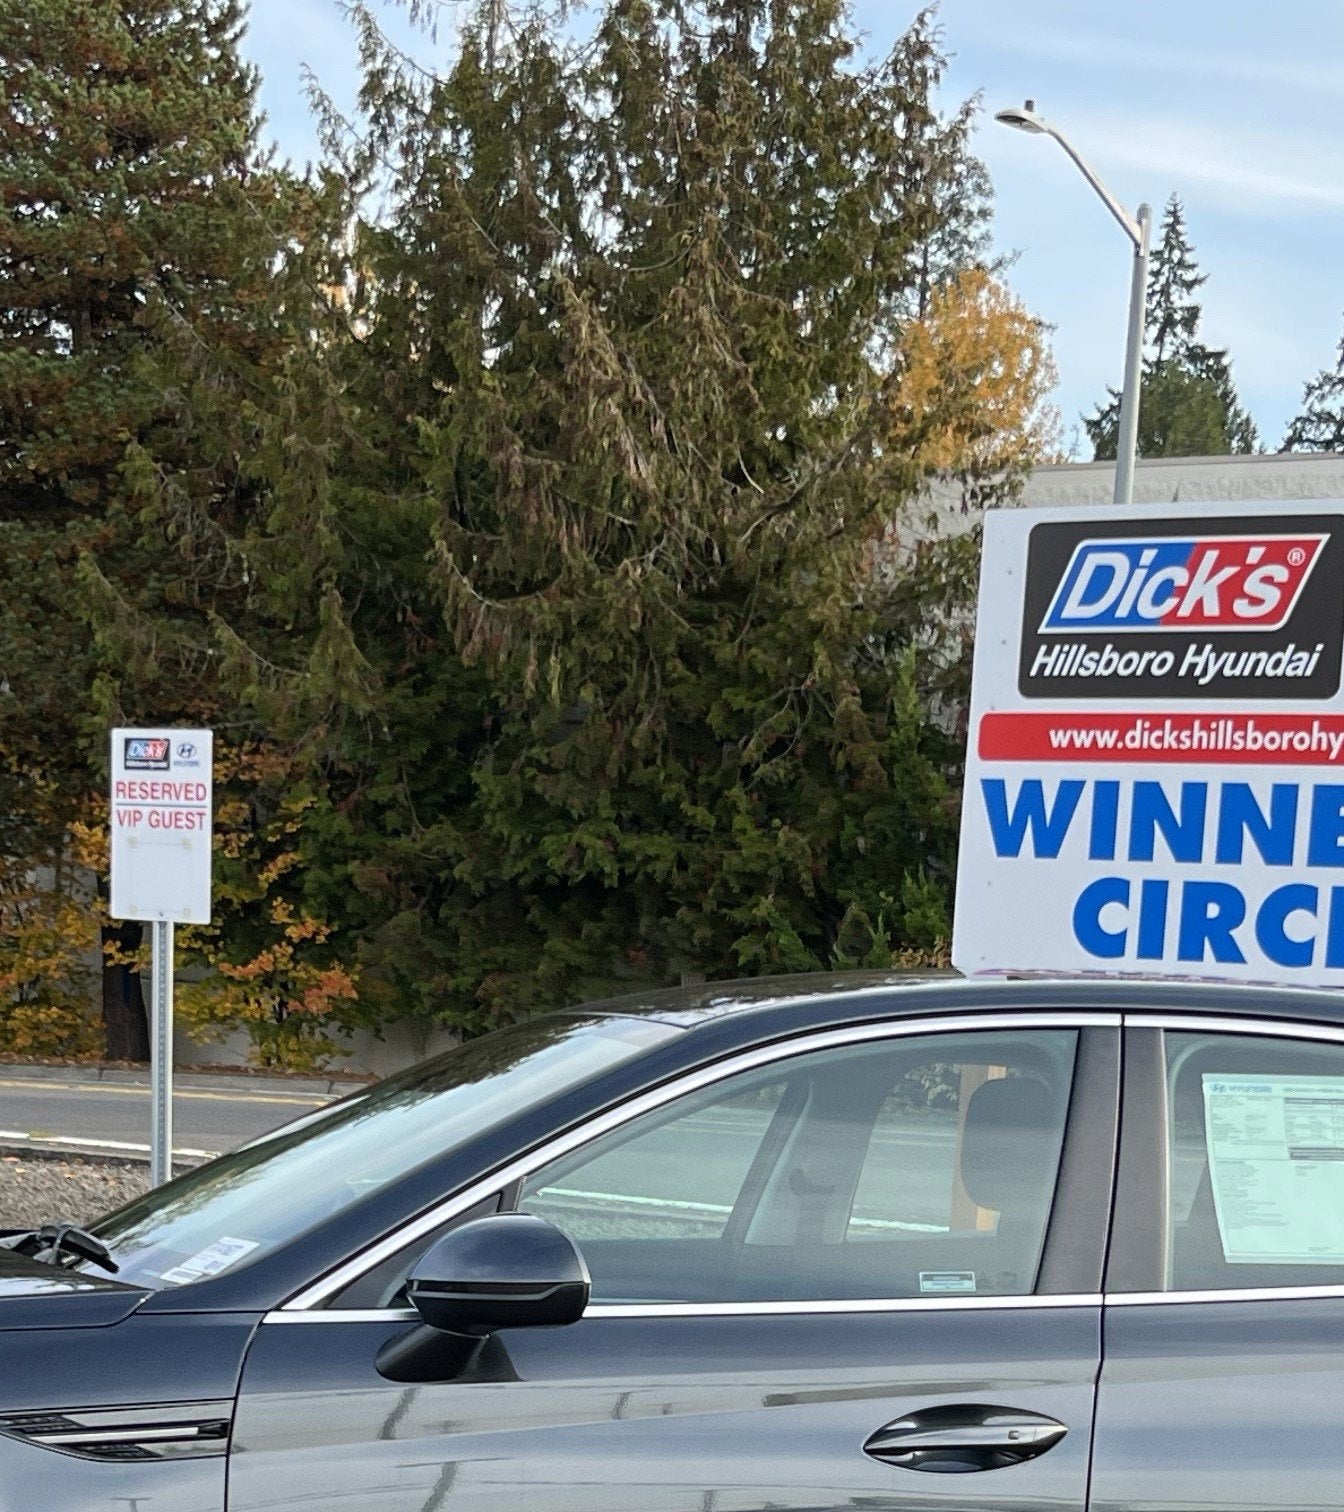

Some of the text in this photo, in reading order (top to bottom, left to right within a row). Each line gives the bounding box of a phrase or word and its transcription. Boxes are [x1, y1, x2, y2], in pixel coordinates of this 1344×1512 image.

[1059, 545, 1291, 621] Dick's
[1029, 642, 1324, 684] Hillsboro Hyundai
[115, 781, 207, 802] RESERVED
[116, 809, 207, 830] VIP GUEST
